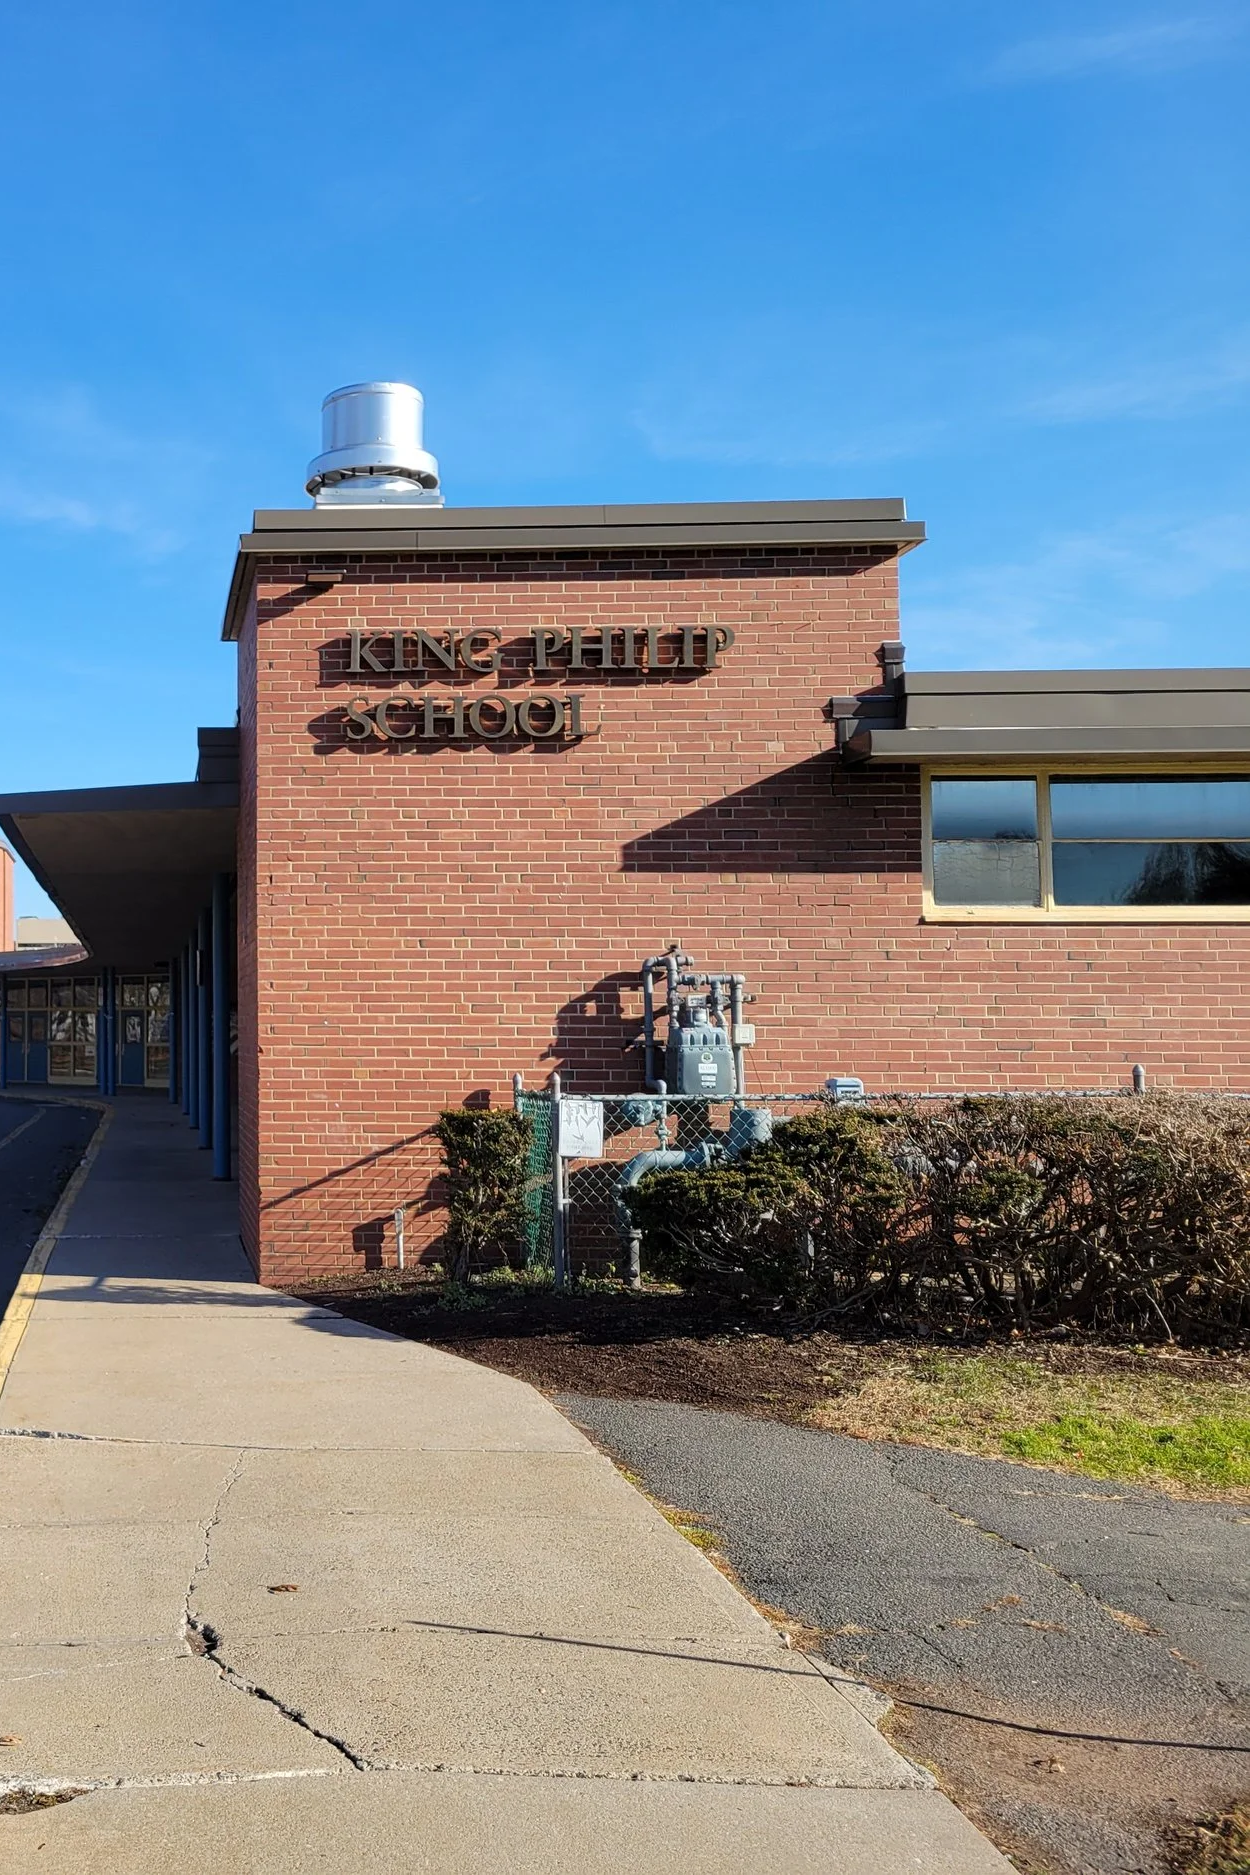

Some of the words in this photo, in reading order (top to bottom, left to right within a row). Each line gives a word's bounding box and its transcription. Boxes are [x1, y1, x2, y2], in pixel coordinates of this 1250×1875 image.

[345, 628, 505, 674] KING
[530, 624, 736, 670] PHILIP
[345, 693, 602, 740] SCHOOL
